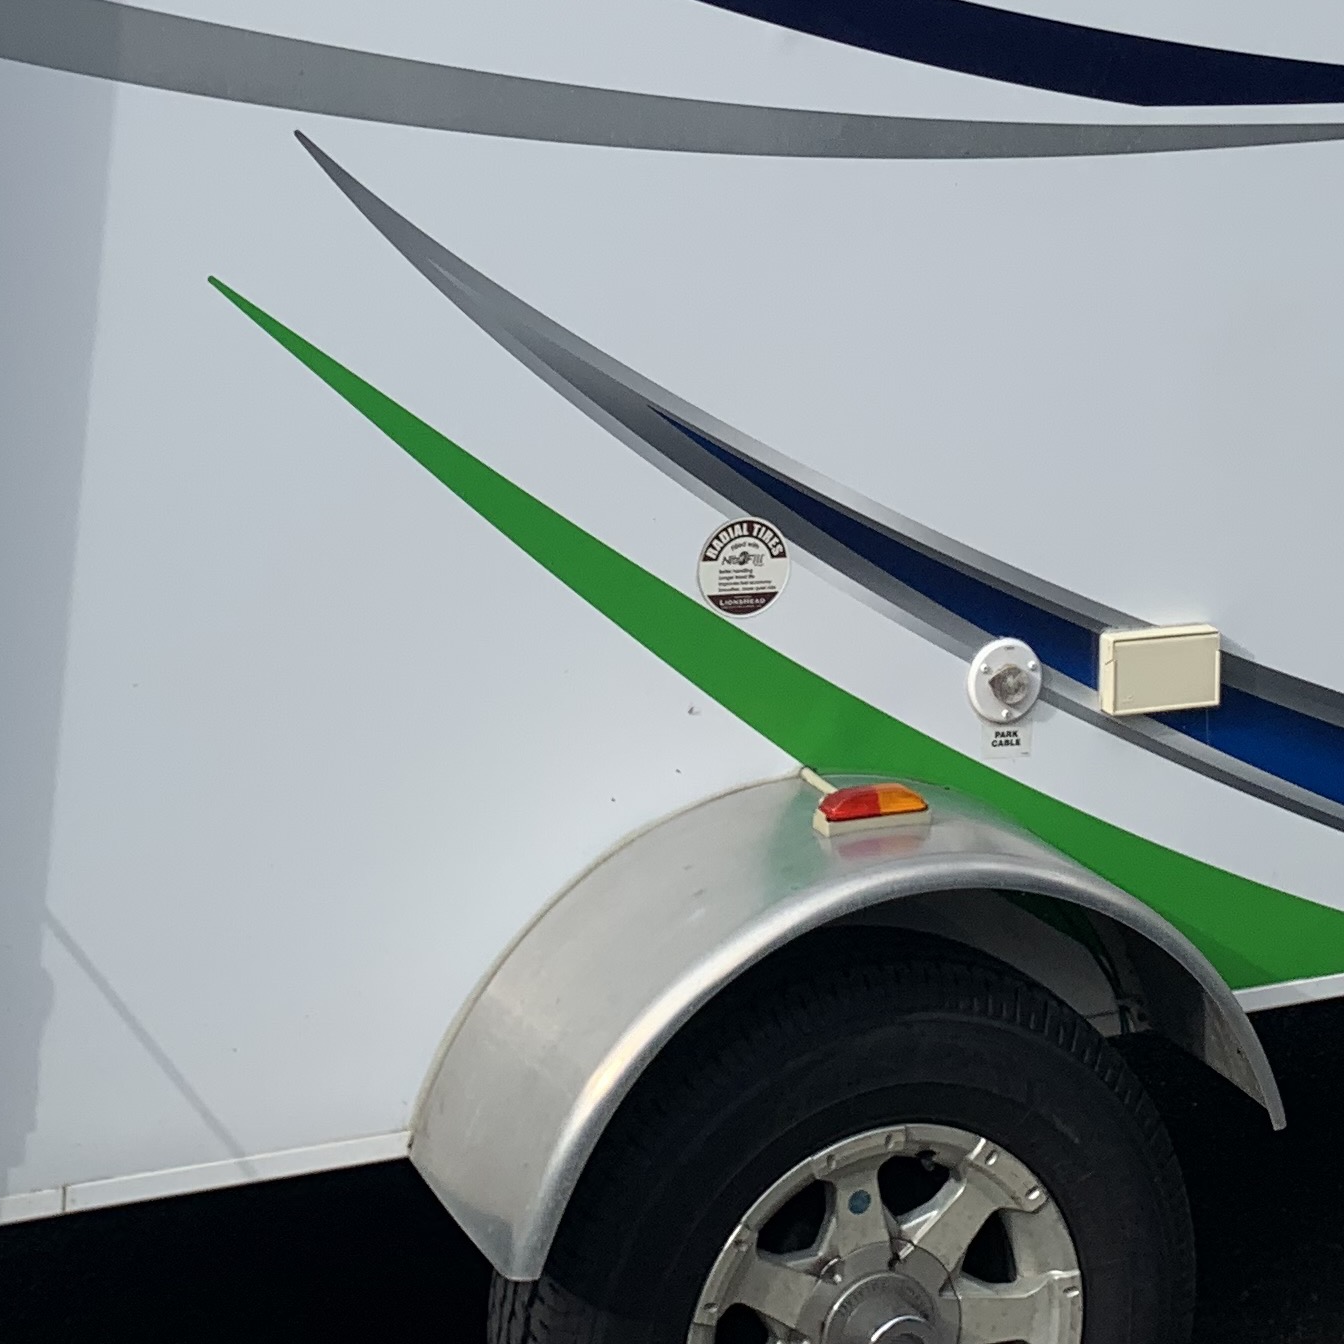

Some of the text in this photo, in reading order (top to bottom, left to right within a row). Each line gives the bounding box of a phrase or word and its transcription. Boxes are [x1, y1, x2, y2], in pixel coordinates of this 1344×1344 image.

[705, 522, 784, 560] RADIAL TIRES
[994, 730, 1018, 739] PARK
[991, 738, 1021, 748] CABLE
